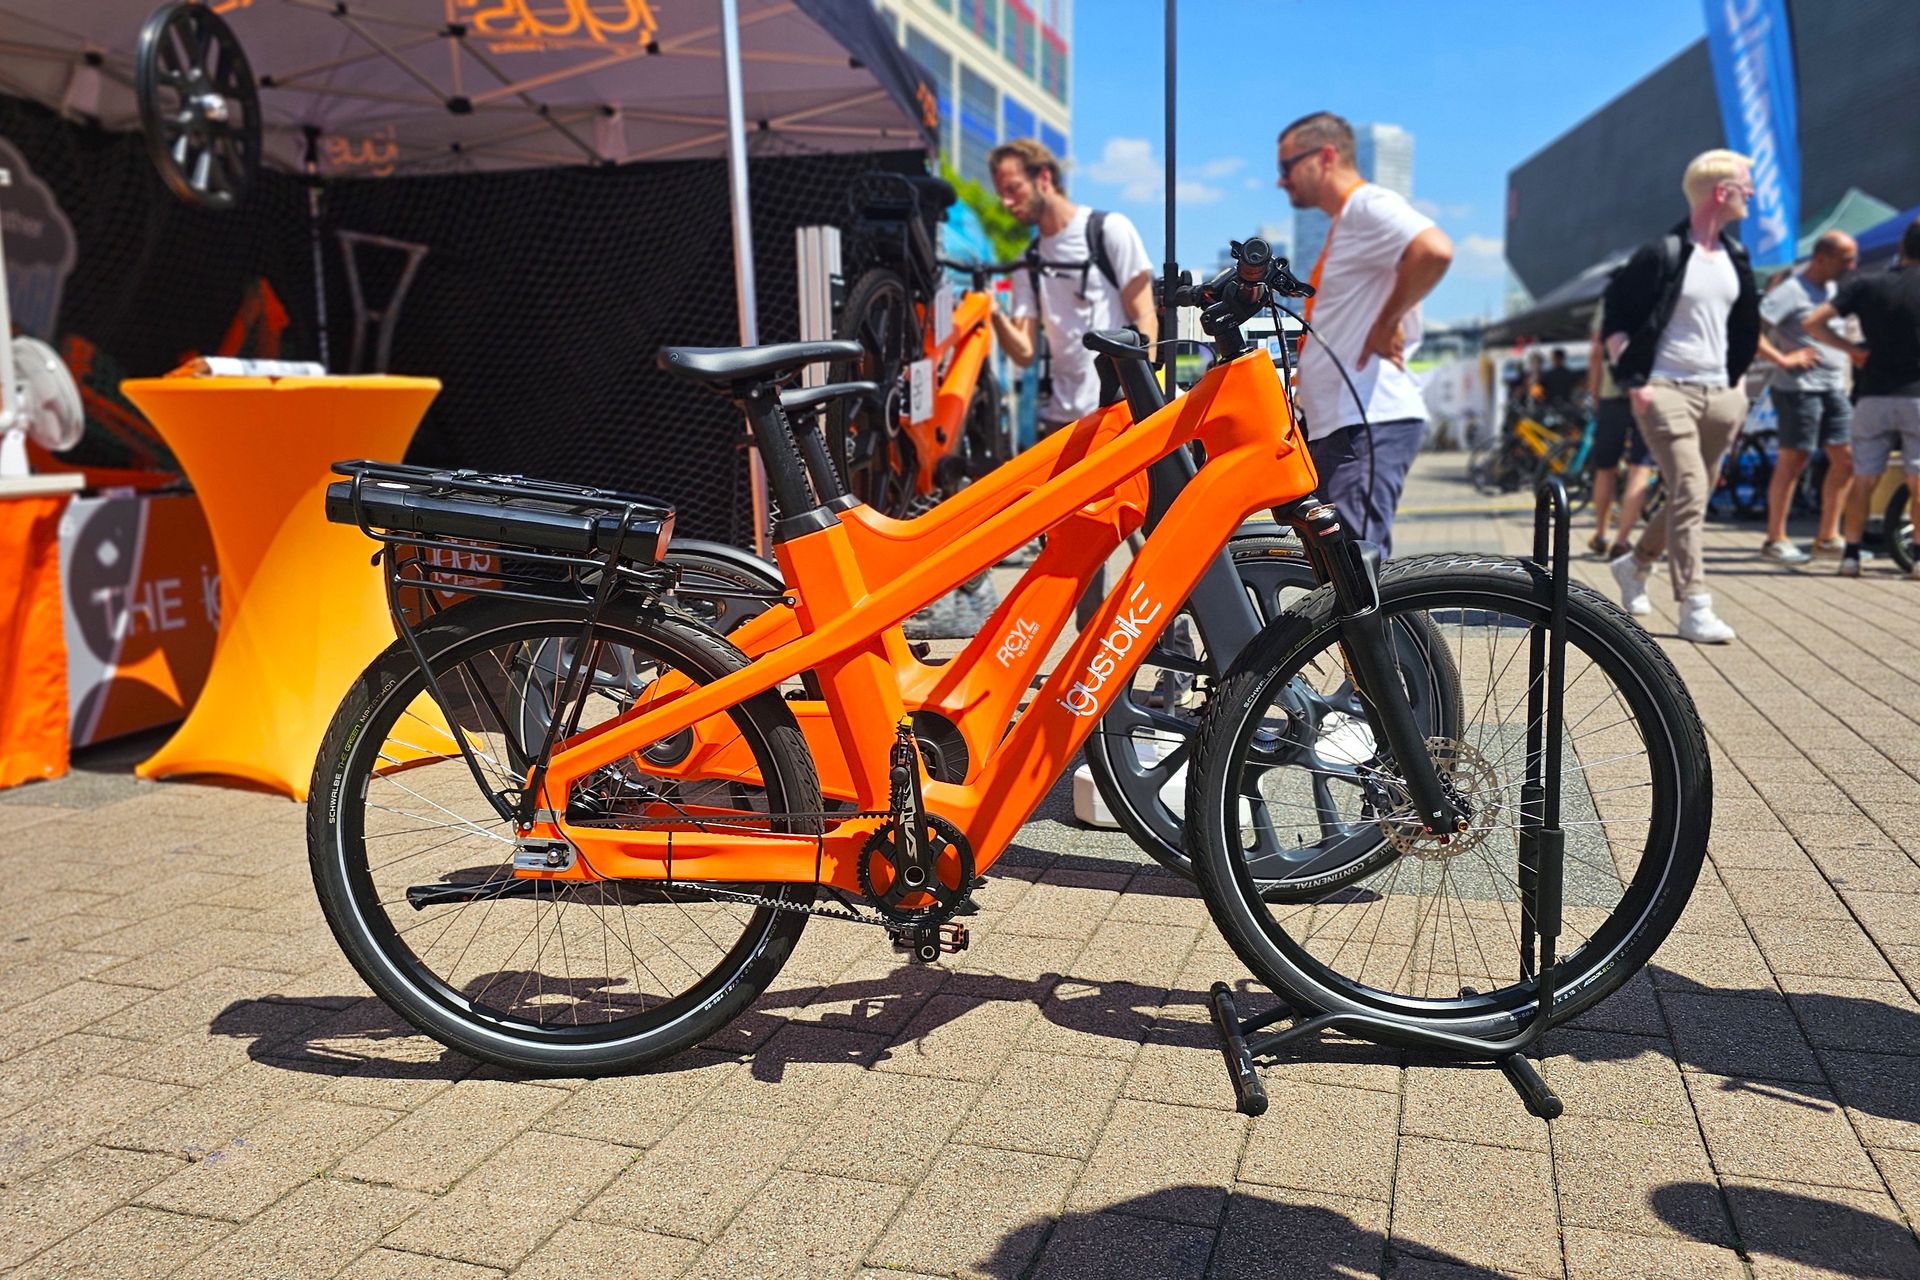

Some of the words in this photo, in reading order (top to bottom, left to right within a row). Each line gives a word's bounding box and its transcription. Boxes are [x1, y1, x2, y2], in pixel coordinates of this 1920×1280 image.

[91, 578, 187, 637] THE
[995, 617, 1035, 668] RCYL
[1243, 665, 1279, 709] SCHWALBE
[328, 773, 343, 825] SCHWALBE
[337, 751, 349, 770] THE
[344, 724, 362, 753] GREEN
[1294, 862, 1366, 891] CONTINENTAL
